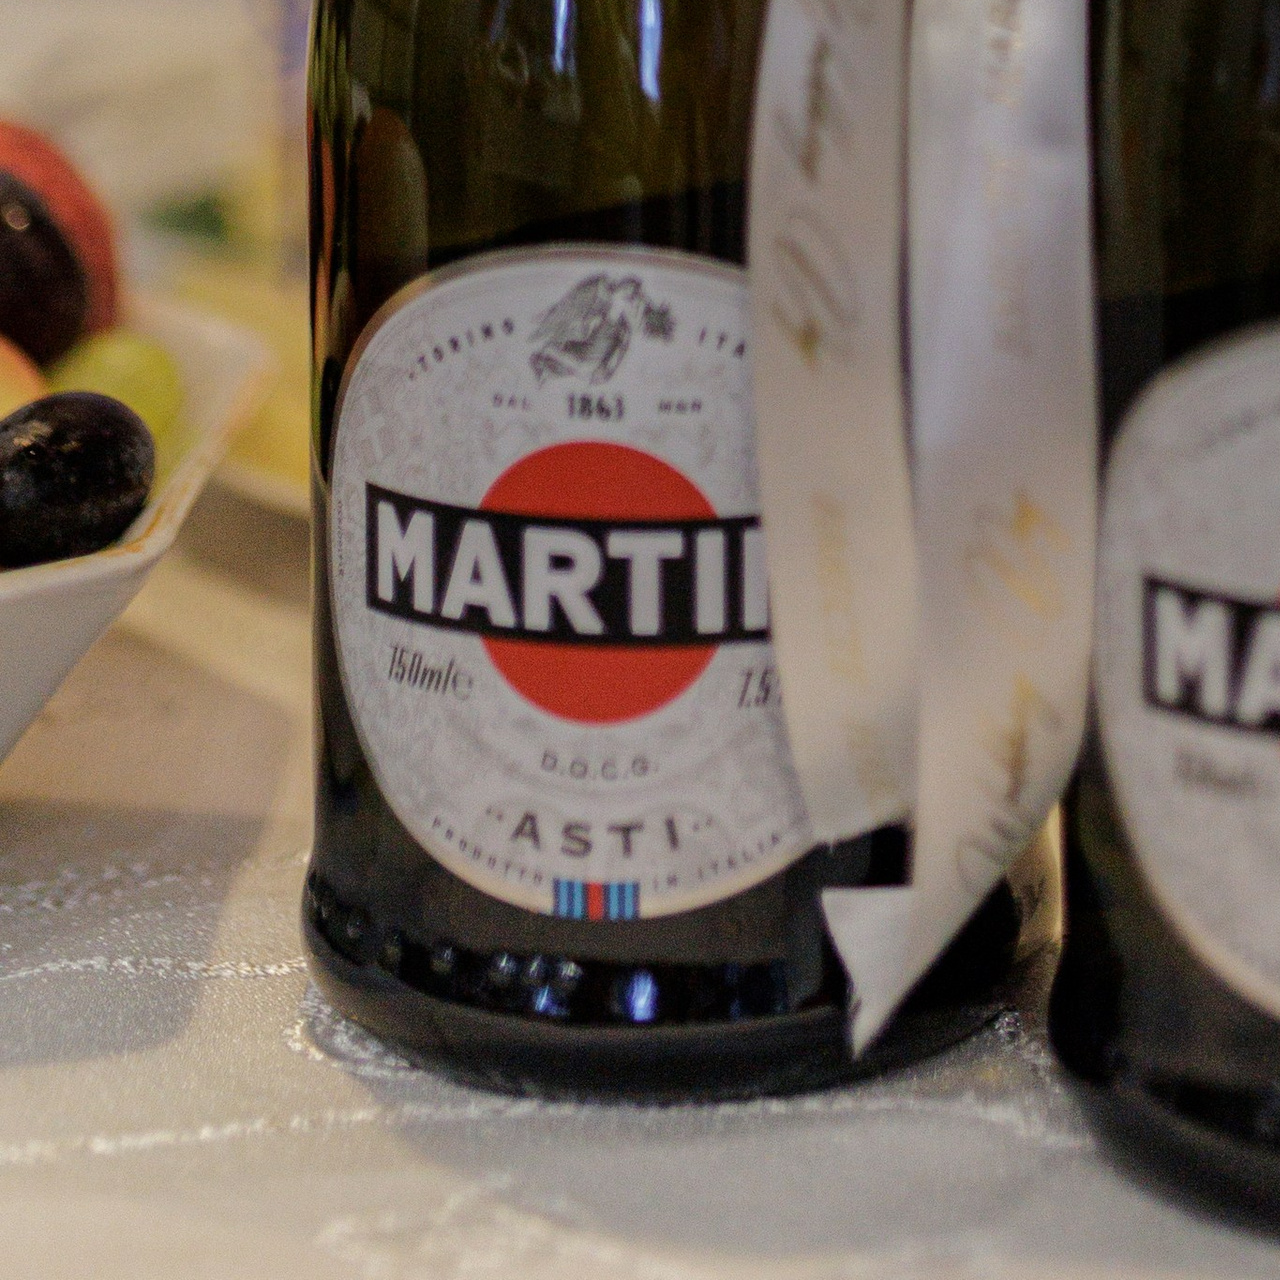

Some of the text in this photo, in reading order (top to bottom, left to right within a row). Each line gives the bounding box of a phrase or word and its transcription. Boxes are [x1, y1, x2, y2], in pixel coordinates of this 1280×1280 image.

[698, 326, 748, 360] ITA
[375, 499, 767, 637] MARTI
[511, 810, 680, 859] ASTI
